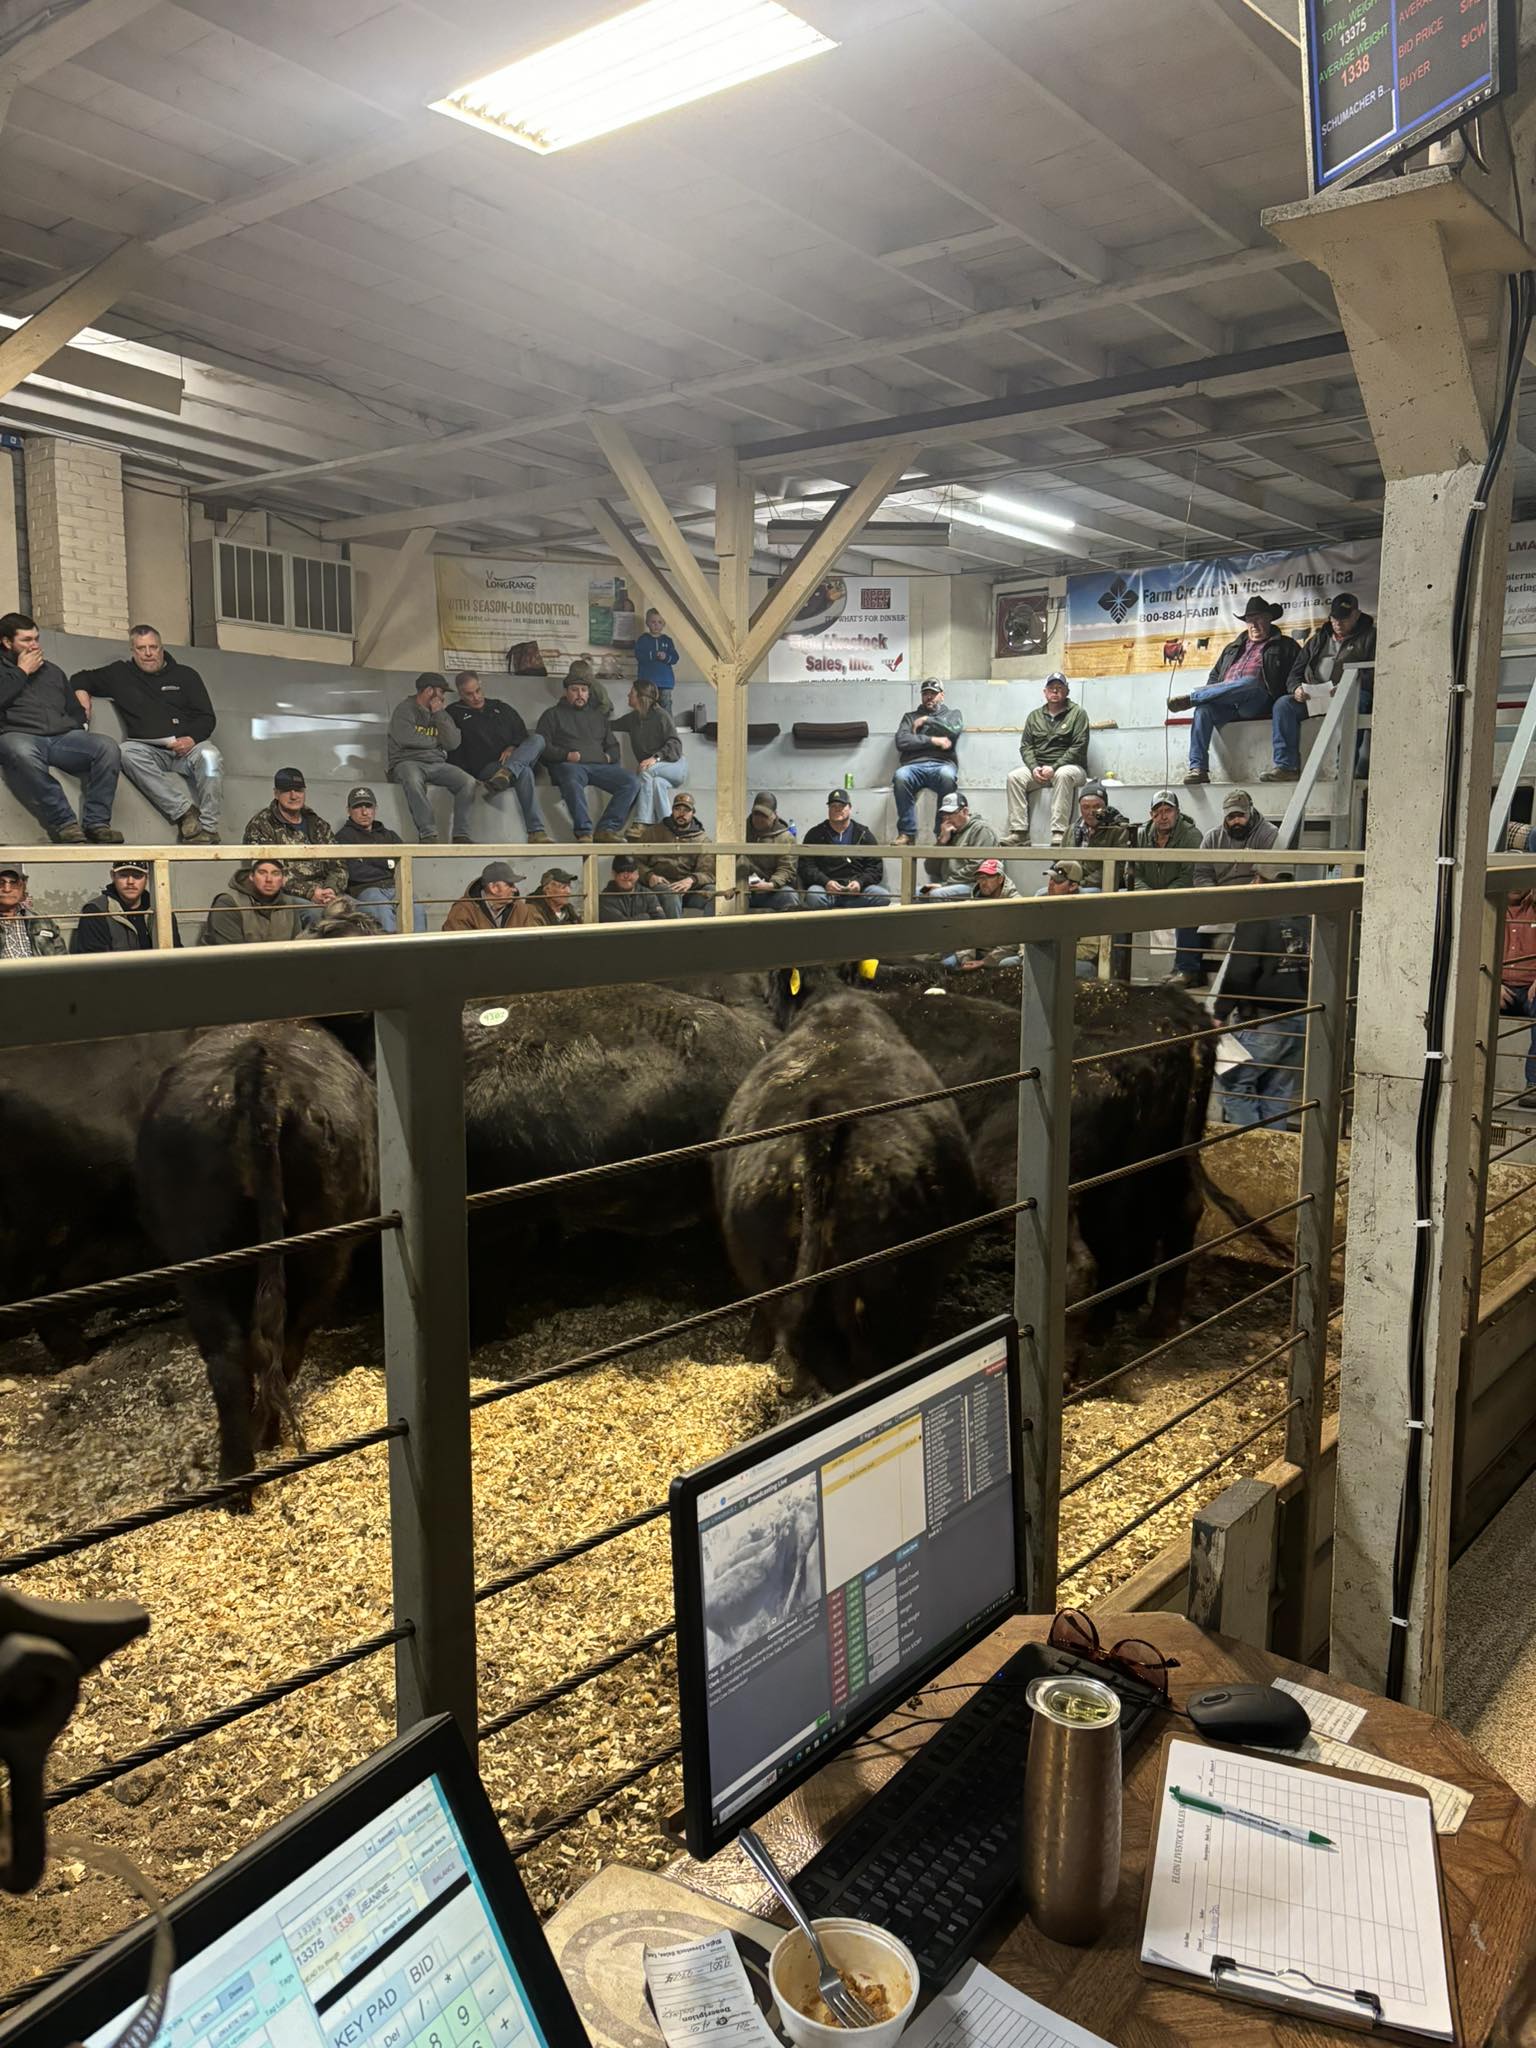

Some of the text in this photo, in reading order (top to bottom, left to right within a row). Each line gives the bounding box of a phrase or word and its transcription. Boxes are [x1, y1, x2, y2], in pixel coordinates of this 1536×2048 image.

[1321, 0, 1378, 45] TOTAL WEIGH
[1340, 16, 1367, 48] 13375
[1398, 16, 1444, 59] BID PRICE
[1319, 22, 1389, 84] AVERAGE WEIGHT
[1340, 54, 1370, 87] 1338
[1400, 59, 1431, 92] BUYER
[1321, 90, 1376, 136] SCHUMACHER
[1143, 569, 1354, 604] Farm Credit Services of America
[473, 600, 533, 615] SEASON-LONG
[864, 614, 879, 622] FOR
[1139, 606, 1219, 623] 800-884-FARM
[805, 655, 847, 675] Sales,
[1173, 1827, 1185, 1862] LIVESTOCK
[1170, 1862, 1182, 1883] ELGIN
[358, 1883, 391, 1912] JEANINE
[332, 1912, 357, 1936] 1338
[295, 1938, 326, 1967] 13375
[409, 1954, 435, 1985] BID
[334, 1987, 398, 2048] KEY PAD
[457, 2005, 471, 2028] 9
[383, 2027, 401, 2048] Del
